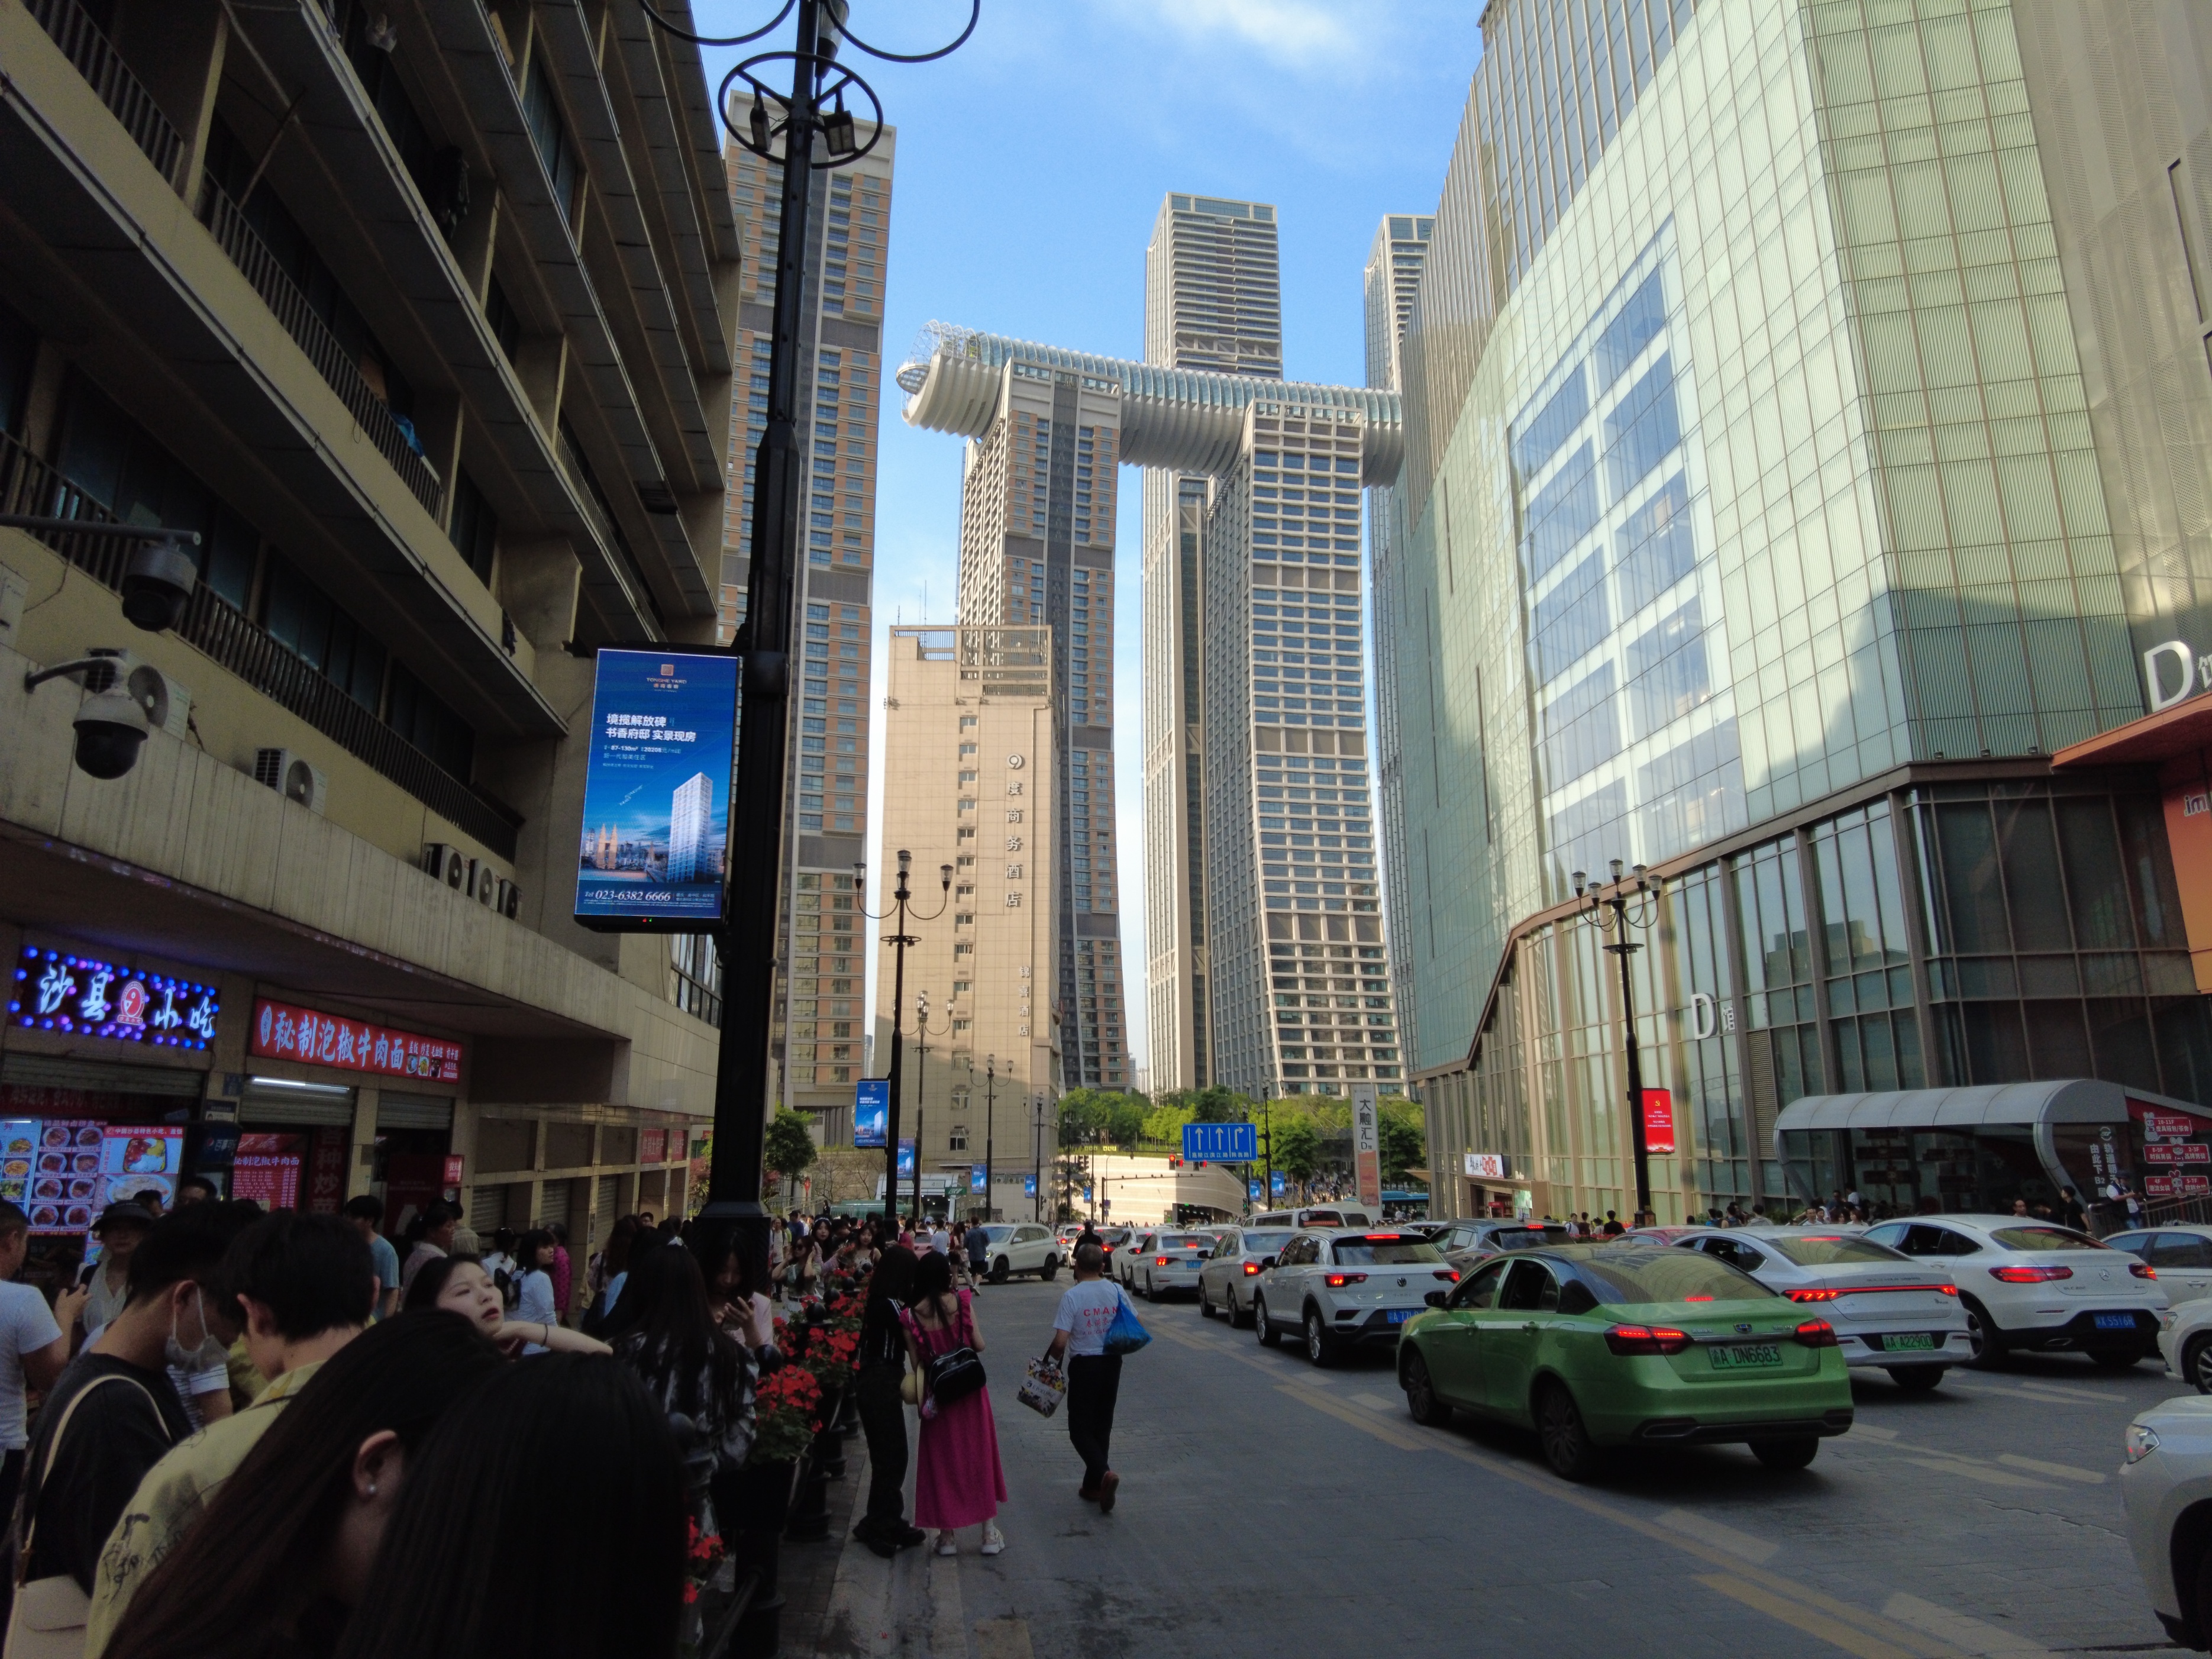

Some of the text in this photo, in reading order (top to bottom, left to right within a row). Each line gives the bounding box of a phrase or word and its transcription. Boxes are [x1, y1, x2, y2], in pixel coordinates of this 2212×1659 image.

[606, 714, 667, 727] 境揽解放碑
[605, 728, 697, 742] 书香府邸 实景现房
[595, 890, 644, 900] 023-6382
[645, 892, 671, 901] 6666
[40, 964, 109, 1021] 沙县
[154, 988, 215, 1038] 小吃
[275, 1012, 404, 1070] 秘制泡椒牛肉面
